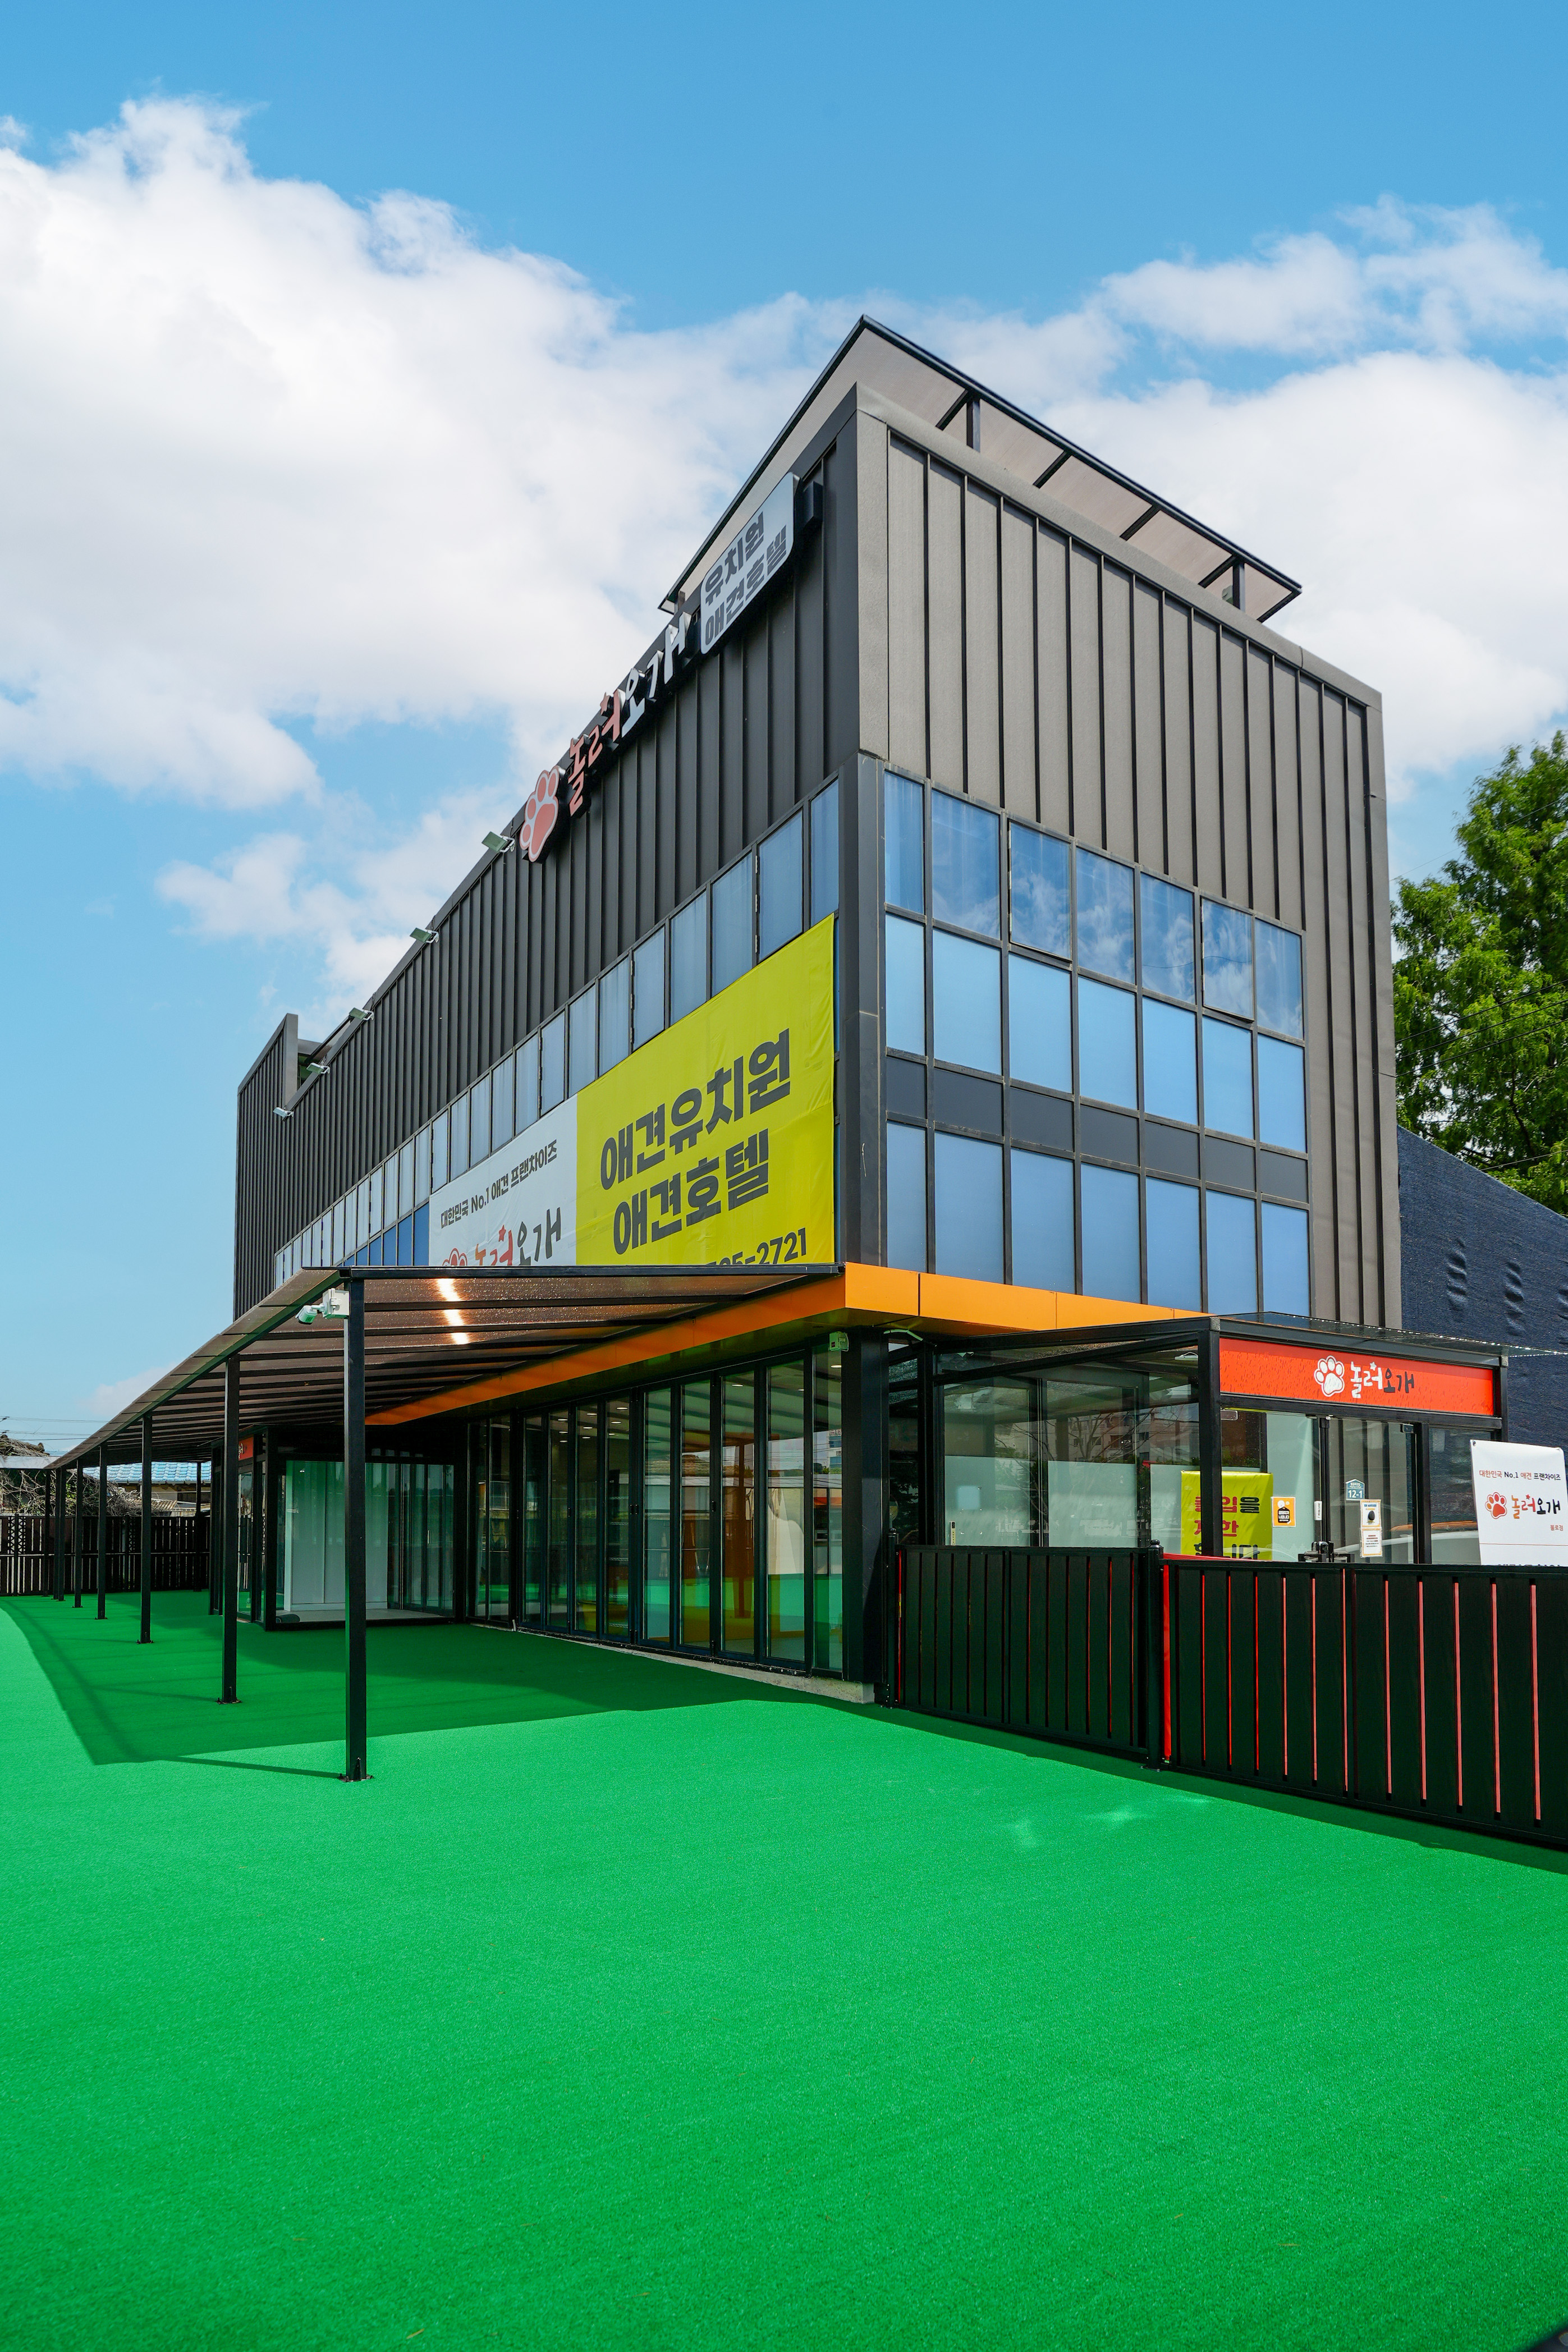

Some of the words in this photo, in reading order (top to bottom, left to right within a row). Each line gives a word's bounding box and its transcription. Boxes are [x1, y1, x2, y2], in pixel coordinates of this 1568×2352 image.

[705, 511, 764, 607] 유치원
[705, 524, 787, 646] 애견호텔
[567, 611, 688, 818] 놀러오개
[600, 1028, 791, 1191] 애견유치원
[441, 1199, 469, 1229] 대한민국
[471, 1186, 489, 1214] No.1
[491, 1173, 509, 1200] 애견
[511, 1139, 557, 1189] 프랜차이즈
[613, 1128, 769, 1255] 애견호텔
[705, 1227, 806, 1265] -2721
[1350, 1361, 1415, 1399] 놀러오개
[1348, 1489, 1363, 1498] 12-1
[1479, 1470, 1503, 1478] 대한민국
[1511, 1494, 1561, 1520] 놀러오개
